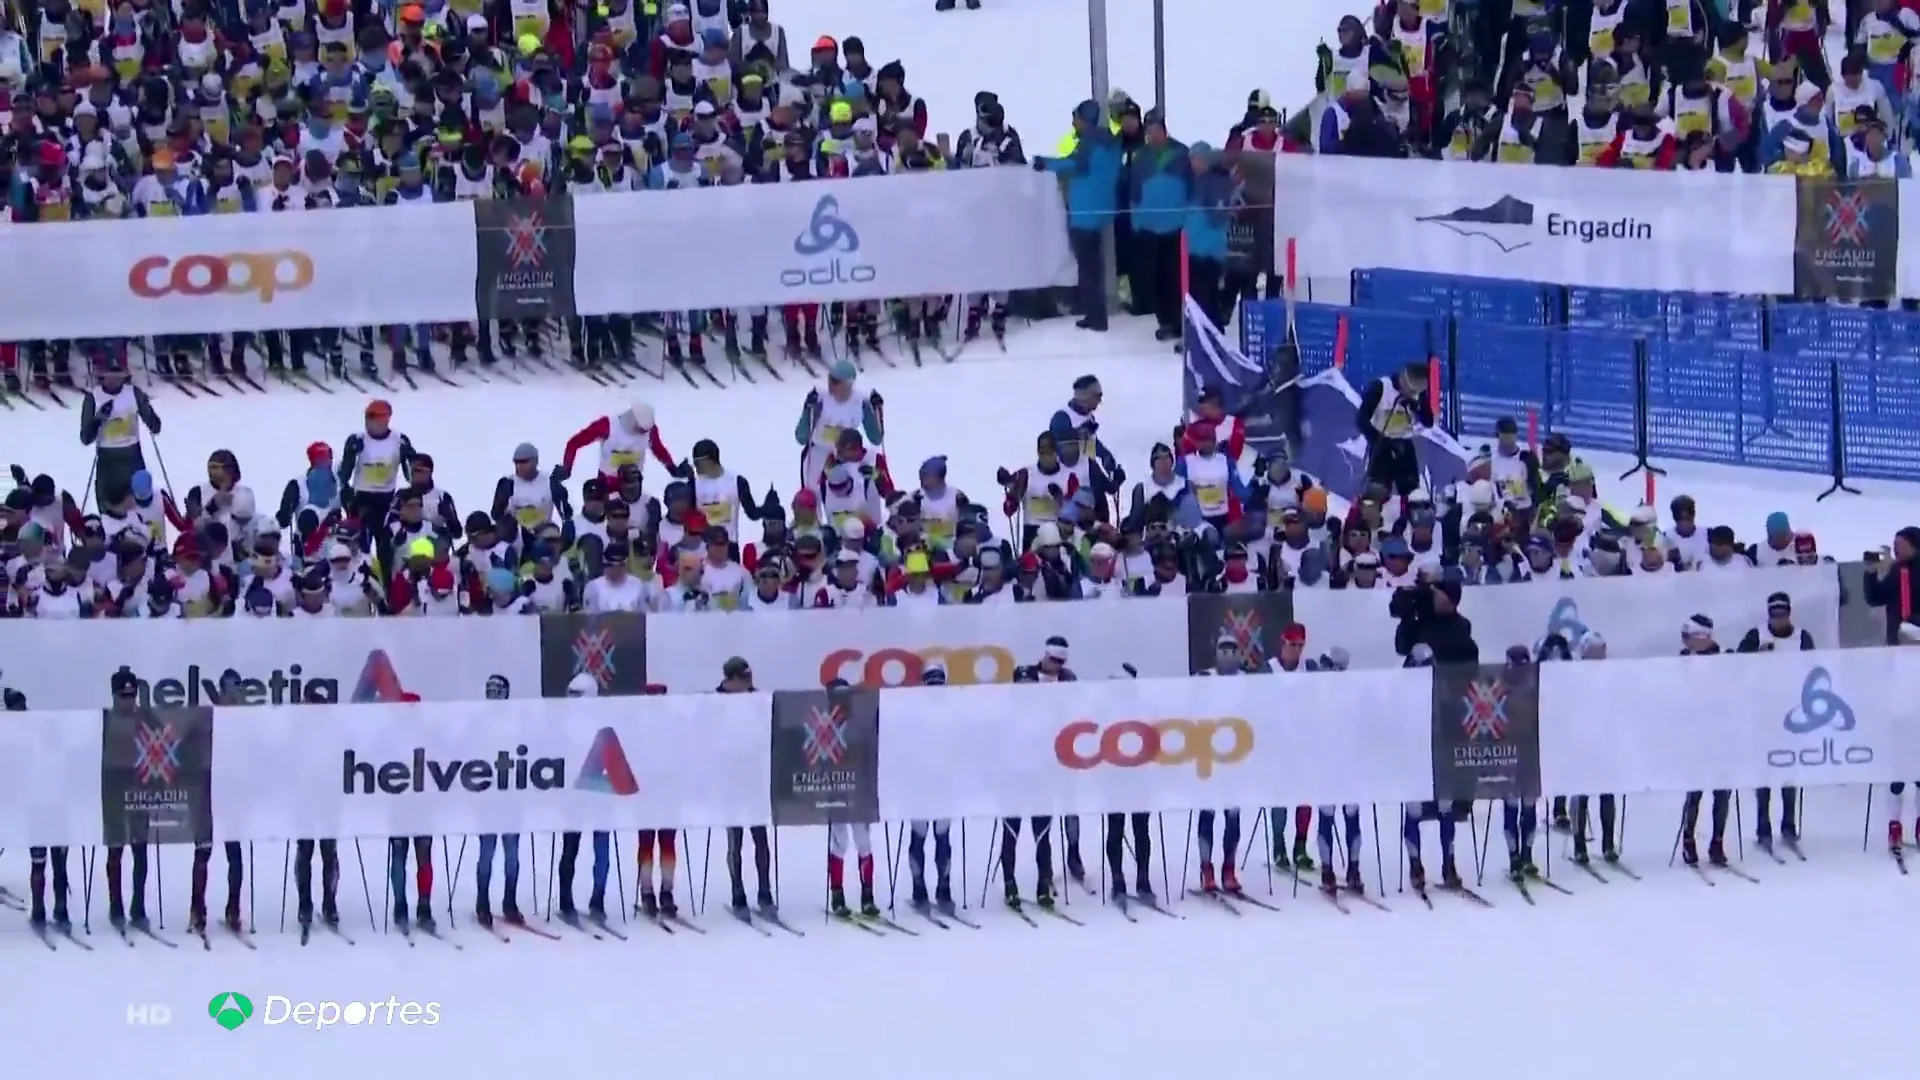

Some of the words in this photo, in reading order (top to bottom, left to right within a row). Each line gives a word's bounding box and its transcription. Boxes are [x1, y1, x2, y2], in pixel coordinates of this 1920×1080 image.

[1547, 212, 1653, 242] Engadin
[1814, 249, 1876, 261] ENGADIN
[128, 249, 315, 304] coop
[780, 257, 876, 287] odlo
[1054, 717, 1254, 779] coop
[1454, 744, 1518, 760] ENGADIN
[1767, 737, 1874, 768] odlo
[342, 744, 566, 795] helvetia
[792, 771, 856, 784] ENGADIN
[124, 789, 189, 803] ENGADIN
